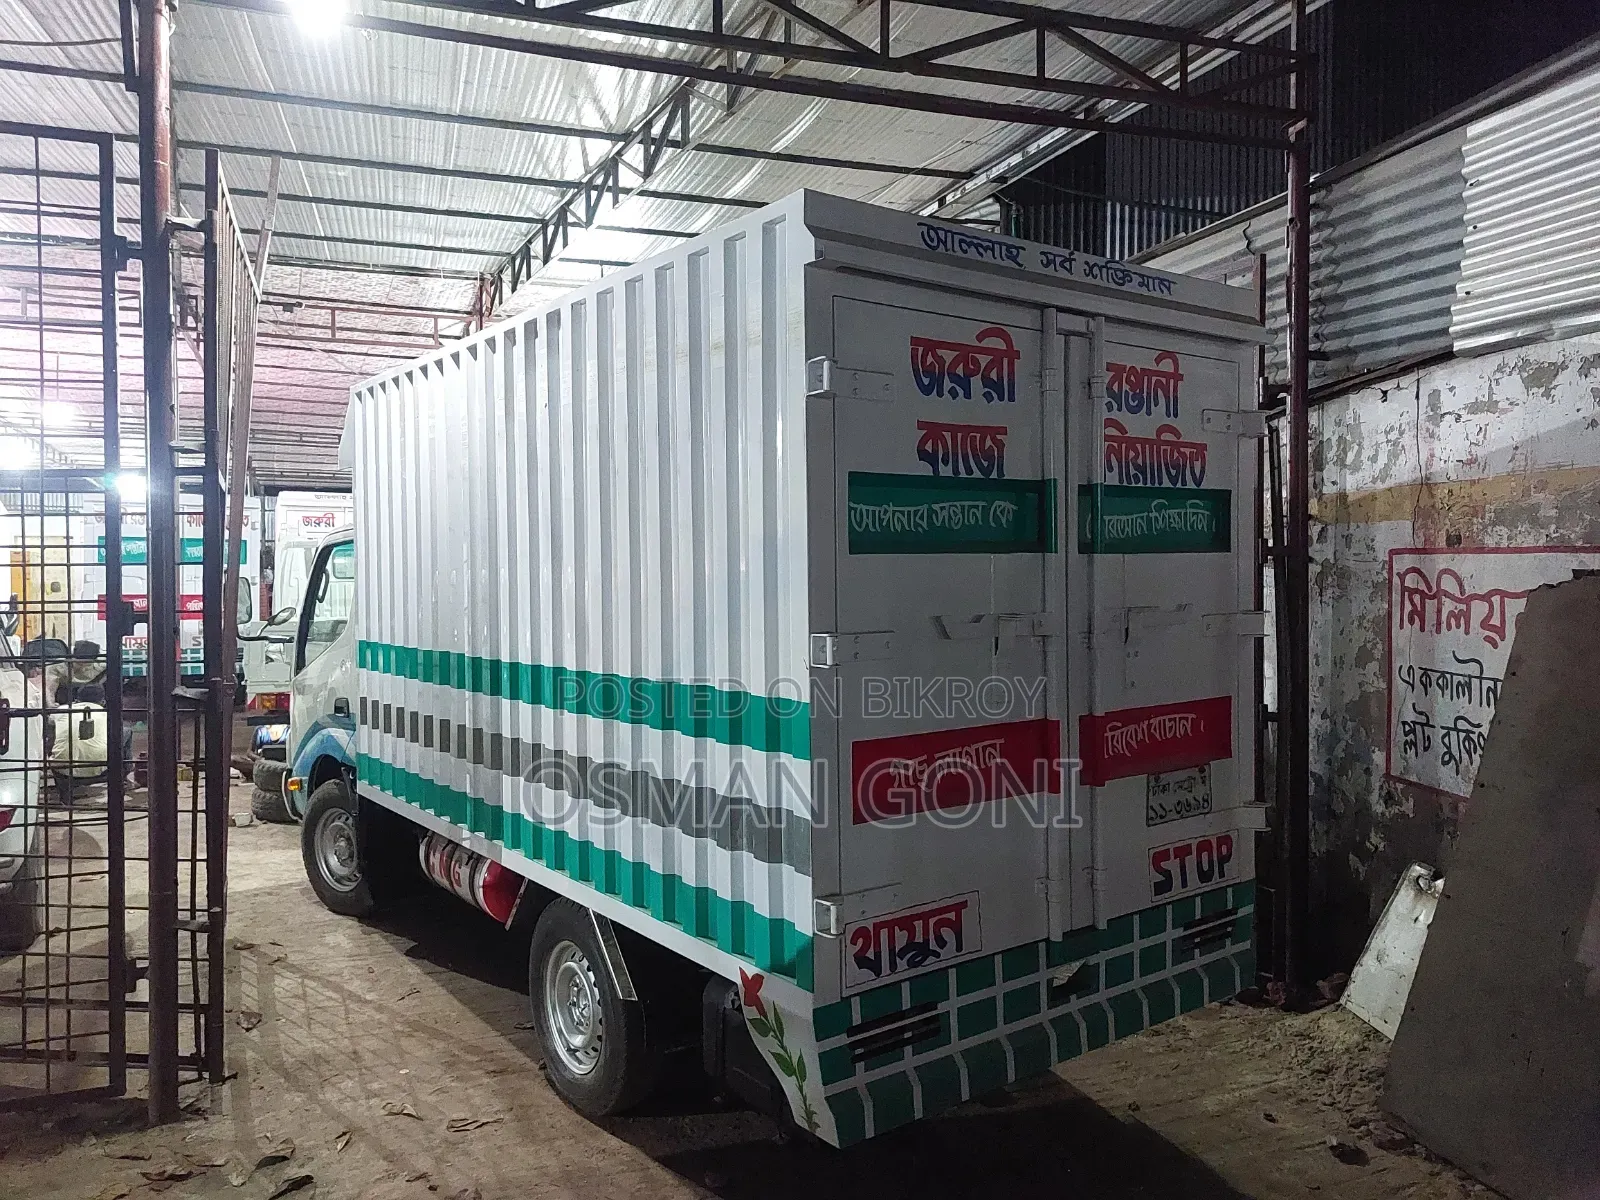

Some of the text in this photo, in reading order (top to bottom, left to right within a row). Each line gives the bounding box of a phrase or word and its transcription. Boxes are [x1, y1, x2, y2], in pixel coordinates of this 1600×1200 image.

[1039, 250, 1077, 276] সর্ব
[909, 326, 1021, 404] জরুরী
[916, 419, 1008, 479] কাজে
[301, 512, 337, 528] জরুরী
[849, 502, 929, 534] আপনার
[931, 500, 988, 530] সন্তান
[988, 500, 1019, 529] কে
[1396, 565, 1529, 649] মিলিয়
[1151, 834, 1234, 897] STOP
[850, 899, 969, 978] থামুন
